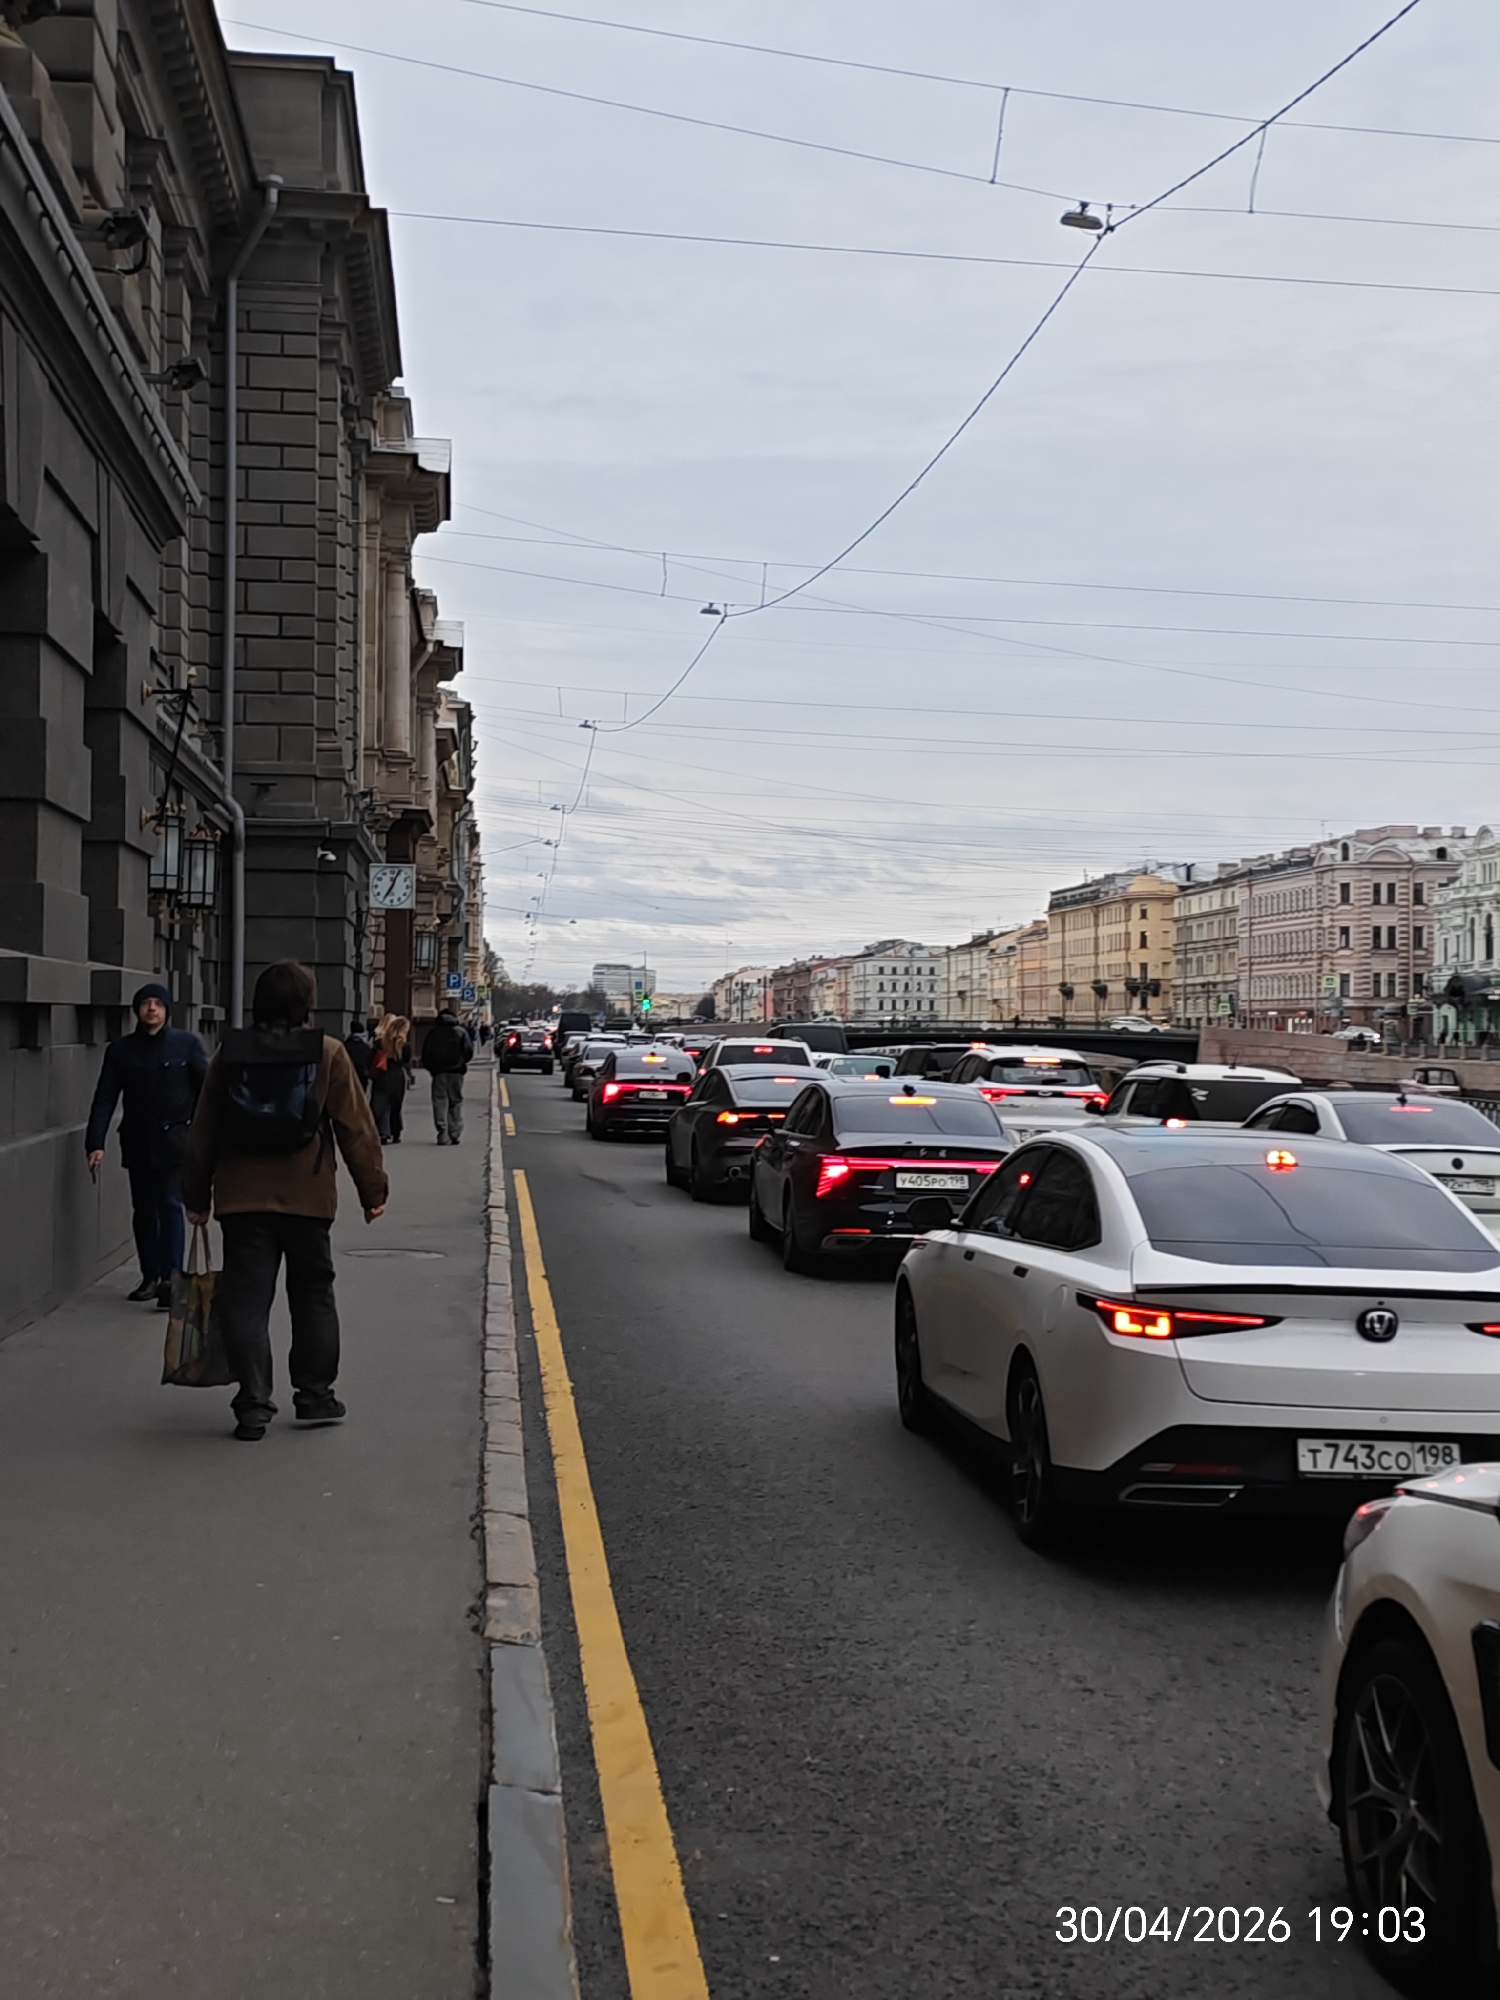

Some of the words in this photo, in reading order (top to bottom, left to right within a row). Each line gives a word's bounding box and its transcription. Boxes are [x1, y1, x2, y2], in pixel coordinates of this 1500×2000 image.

[450, 974, 459, 987] P
[464, 990, 473, 1000] P
[1307, 1442, 1412, 1472] Т743СО
[1416, 1444, 1454, 1466] 198
